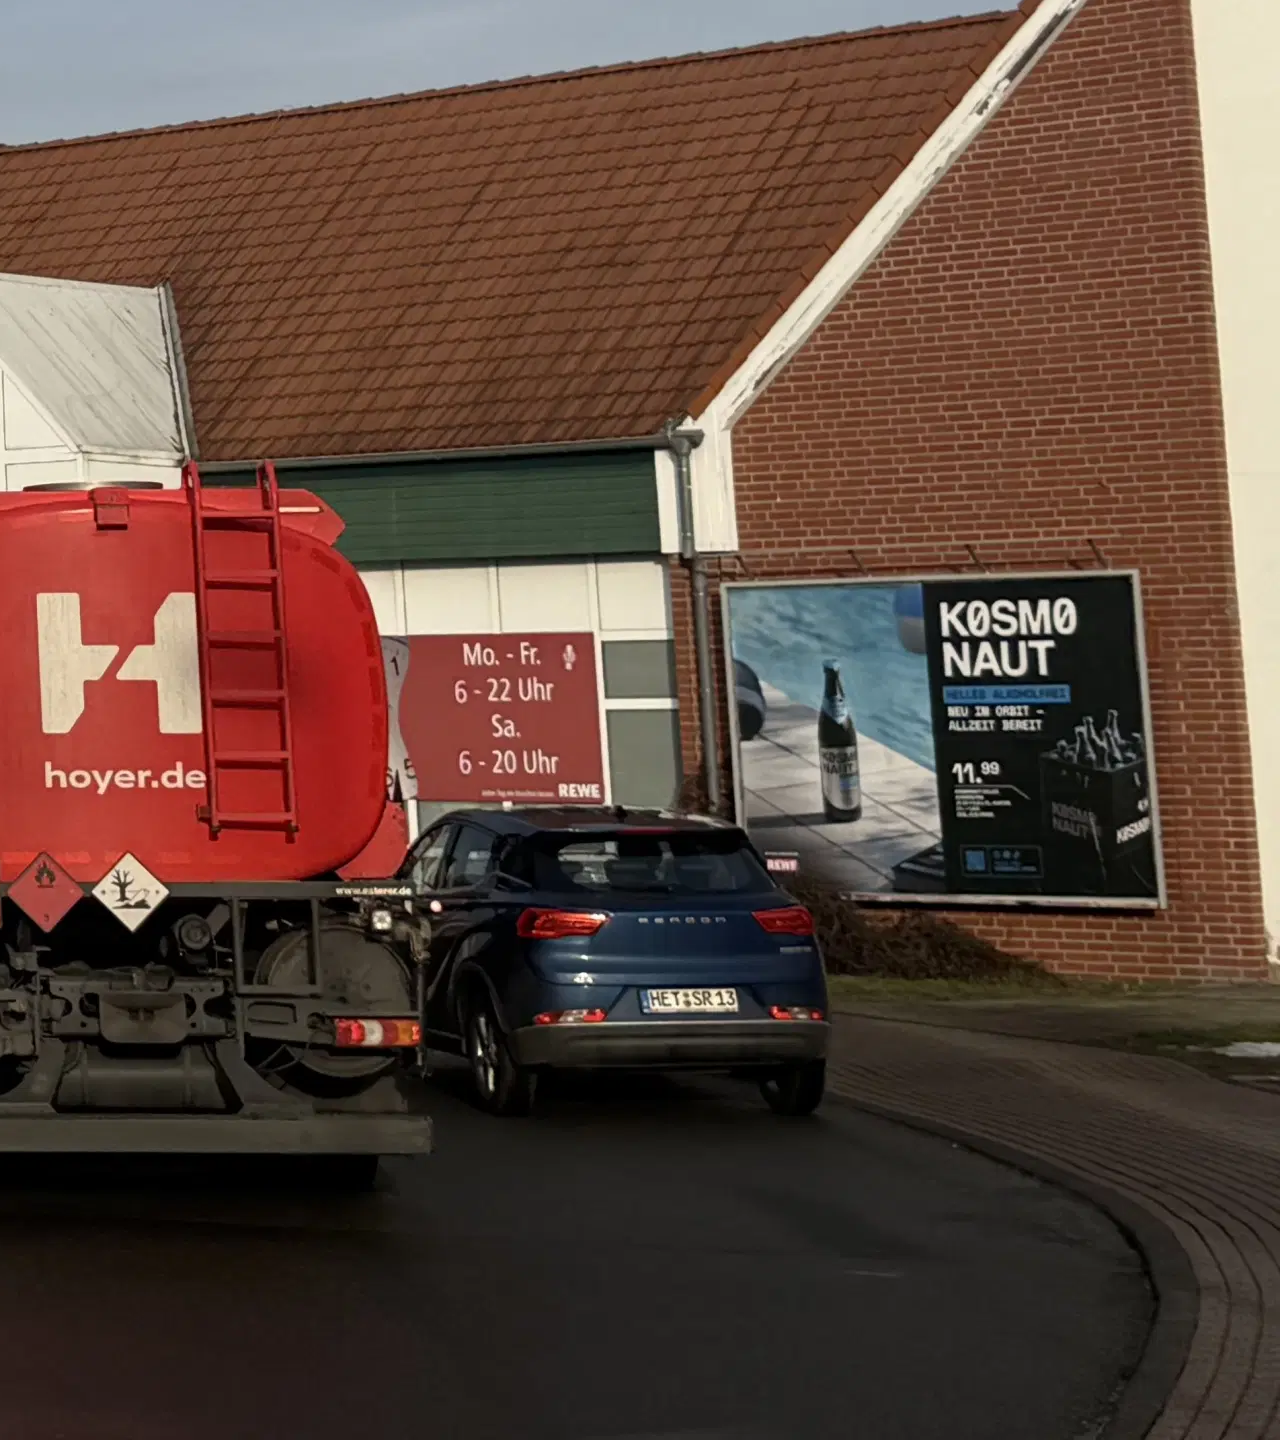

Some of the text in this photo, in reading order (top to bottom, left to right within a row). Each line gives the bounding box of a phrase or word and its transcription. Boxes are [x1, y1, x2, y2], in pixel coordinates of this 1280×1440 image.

[462, 642, 500, 667] Mo.
[519, 641, 541, 666] Fr.
[942, 639, 1056, 678] NAUT
[454, 679, 468, 704] 6
[487, 678, 512, 702] 22
[517, 677, 555, 702] Uhr
[491, 713, 521, 739] Sa.
[458, 750, 472, 775] 6
[492, 750, 518, 775] 20
[522, 747, 560, 775] Uhr
[44, 760, 207, 795] hoyer.de
[557, 783, 601, 799] REWE
[649, 990, 736, 1007] HET SR 13
